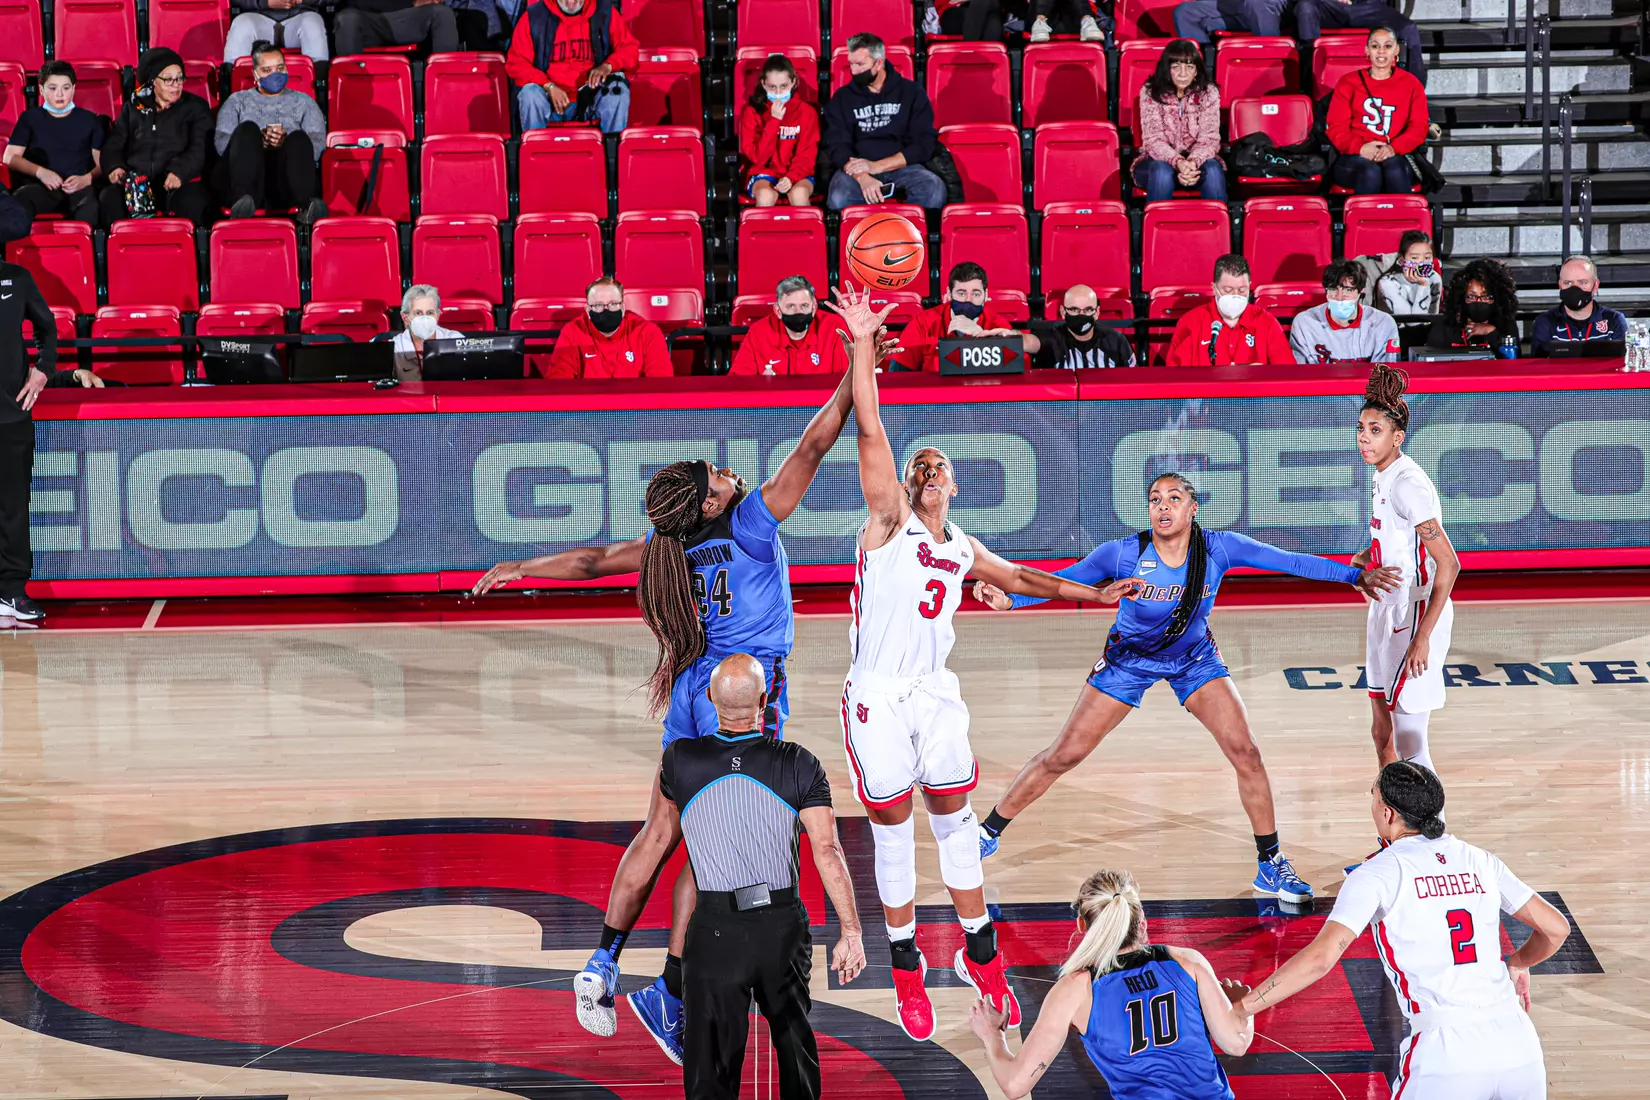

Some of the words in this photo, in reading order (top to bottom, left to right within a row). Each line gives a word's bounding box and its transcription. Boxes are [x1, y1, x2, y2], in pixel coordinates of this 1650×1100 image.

[778, 125, 801, 136] TORM
[962, 345, 1002, 368] POSS
[1112, 419, 1650, 528] GECO
[29, 446, 399, 551] ICO
[691, 568, 733, 617] 24
[918, 578, 947, 619] 3
[1141, 583, 1212, 602] DEPL
[1283, 660, 1650, 690] CRNE
[1414, 872, 1486, 899] CORREA
[1445, 908, 1478, 965] 2
[1124, 989, 1179, 1057] 10
